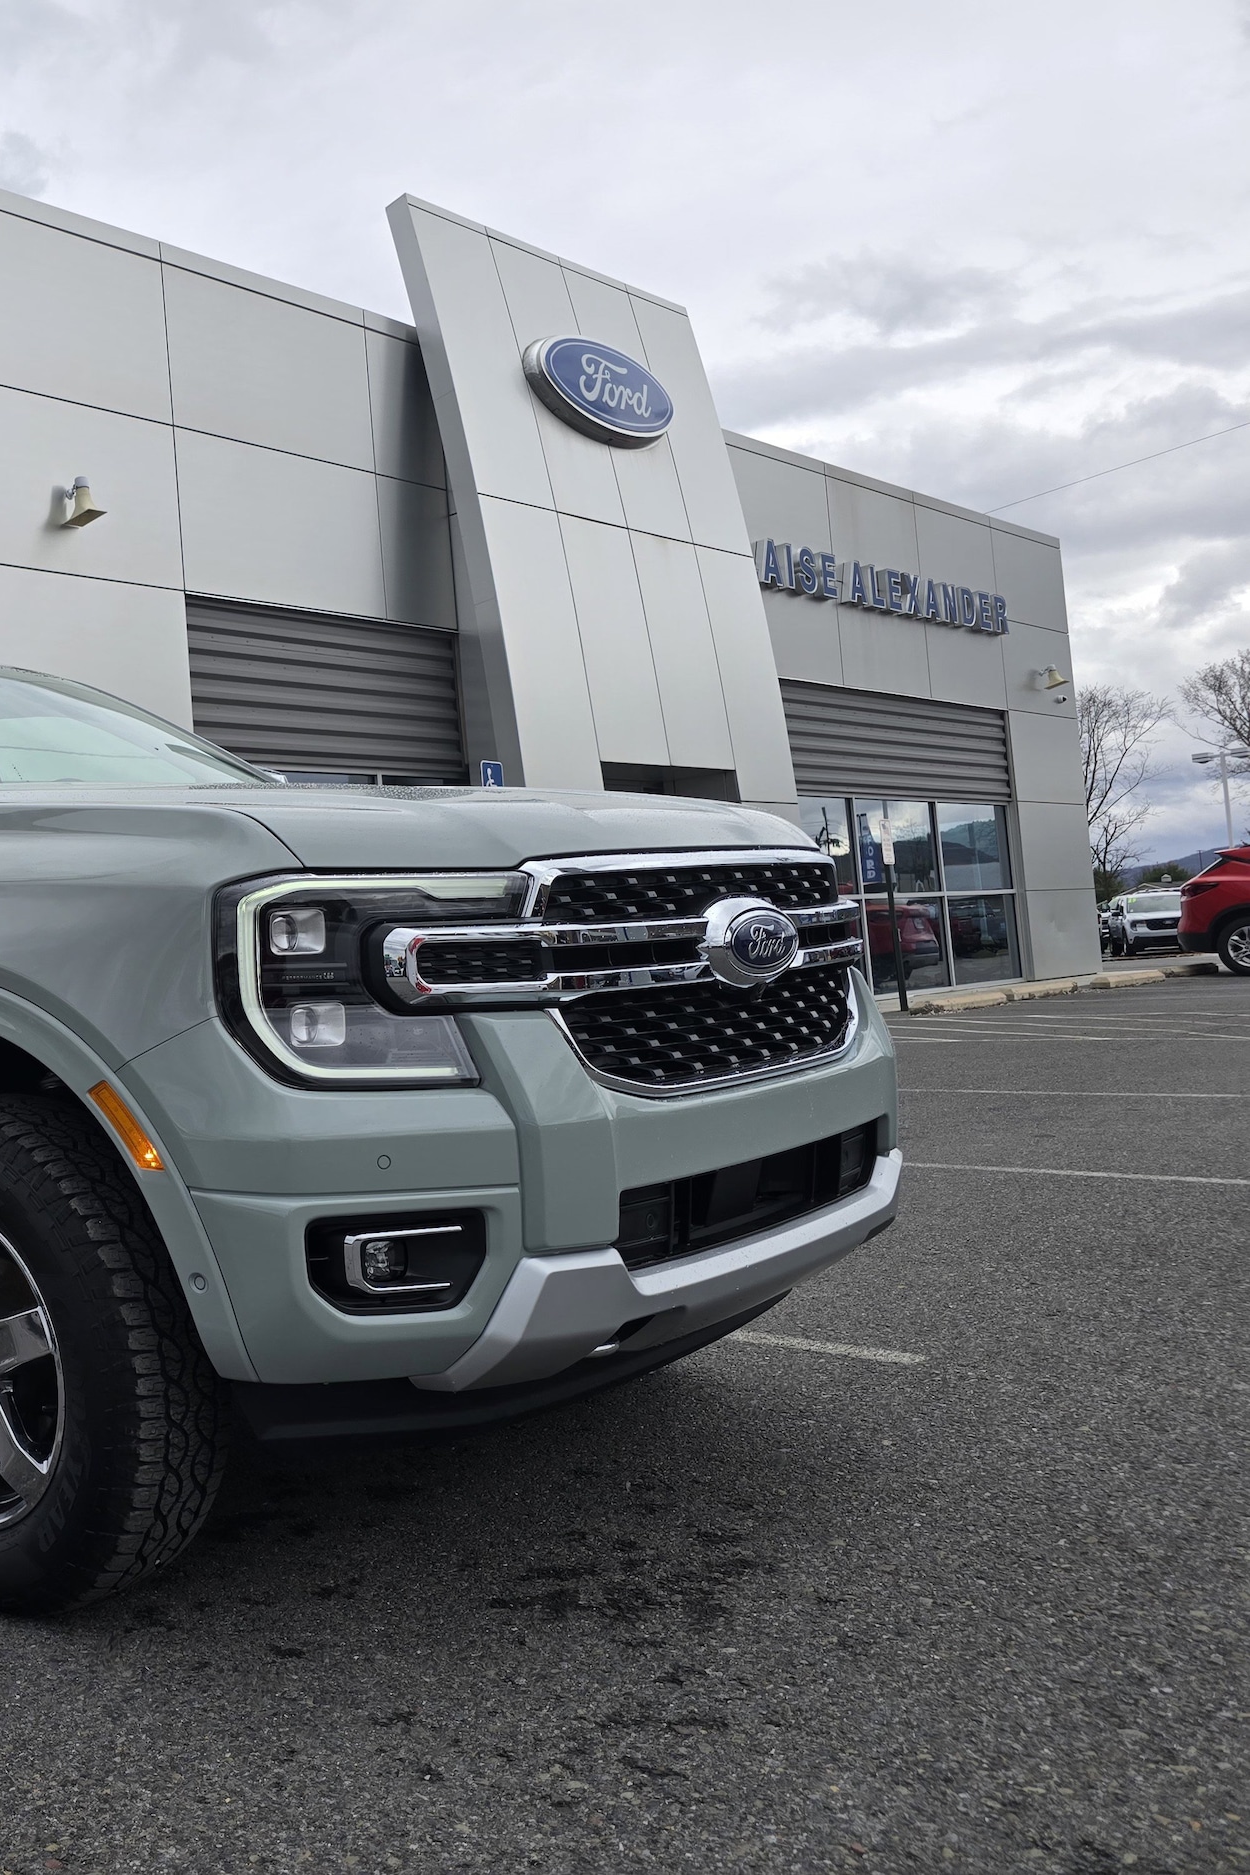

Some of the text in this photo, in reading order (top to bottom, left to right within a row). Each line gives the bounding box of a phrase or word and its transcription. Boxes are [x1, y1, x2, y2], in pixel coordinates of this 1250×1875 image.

[579, 354, 652, 418] Ford
[762, 538, 1010, 634] AISE ALEXANDER
[748, 924, 786, 960] Ford
